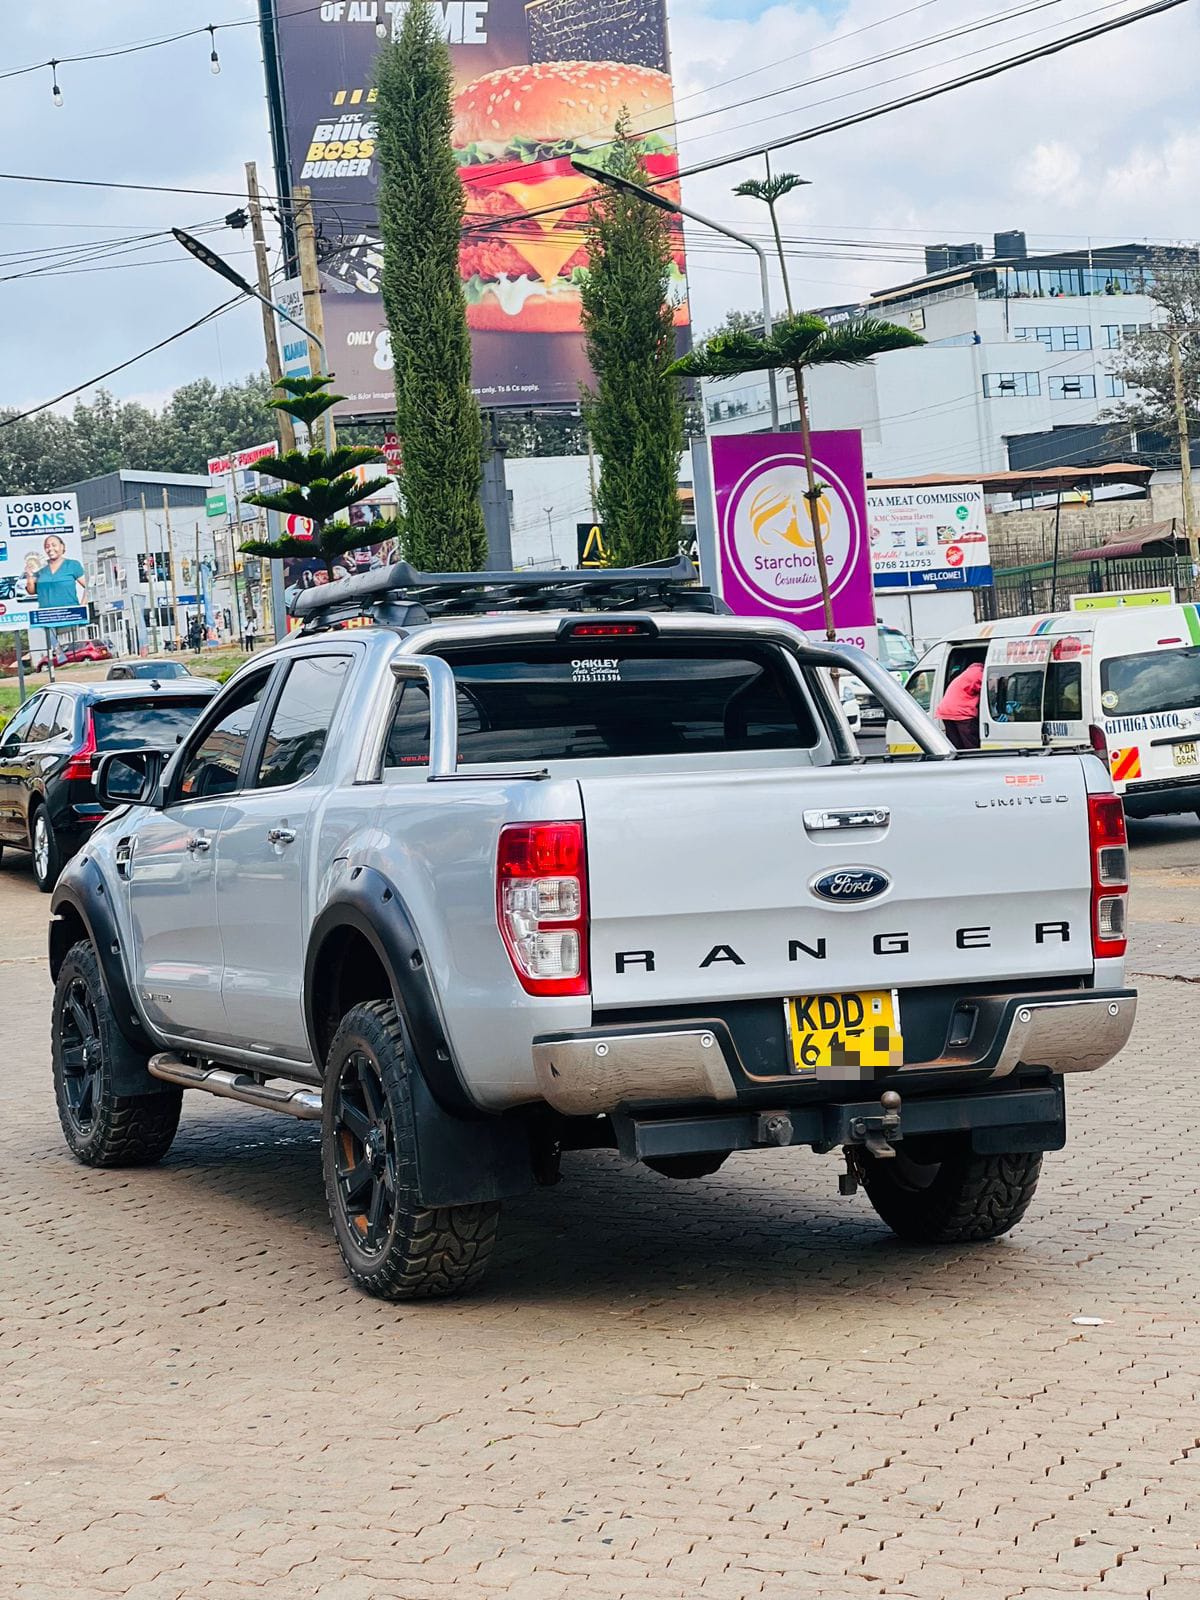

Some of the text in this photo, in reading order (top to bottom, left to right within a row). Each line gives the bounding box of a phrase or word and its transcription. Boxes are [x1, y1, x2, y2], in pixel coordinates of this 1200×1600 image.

[320, 1, 345, 22] OF
[385, 1, 489, 44] TME
[339, 113, 364, 123] KFC
[306, 138, 376, 161] BOSS
[300, 158, 371, 179] BURGER
[346, 330, 375, 346] ONLY
[373, 329, 397, 370] 8
[886, 495, 914, 506] MEAT
[916, 491, 981, 505] COMMISSION
[7, 500, 72, 514] LOGBOOK
[8, 512, 65, 528] LOANS
[891, 513, 913, 522] Nyama
[754, 551, 834, 570] Starchoie
[875, 559, 932, 569] 0768 212753
[775, 572, 817, 587] Cosmetics
[922, 571, 961, 581] WELCOME!
[571, 659, 619, 668] OAKLEY
[1105, 713, 1179, 735] GITHIGA SACCO
[1178, 742, 1196, 754] KDA
[975, 795, 1069, 808] LIMITED
[831, 872, 874, 894] Ford
[614, 921, 1071, 974] RANGER
[794, 993, 865, 1032] KDD
